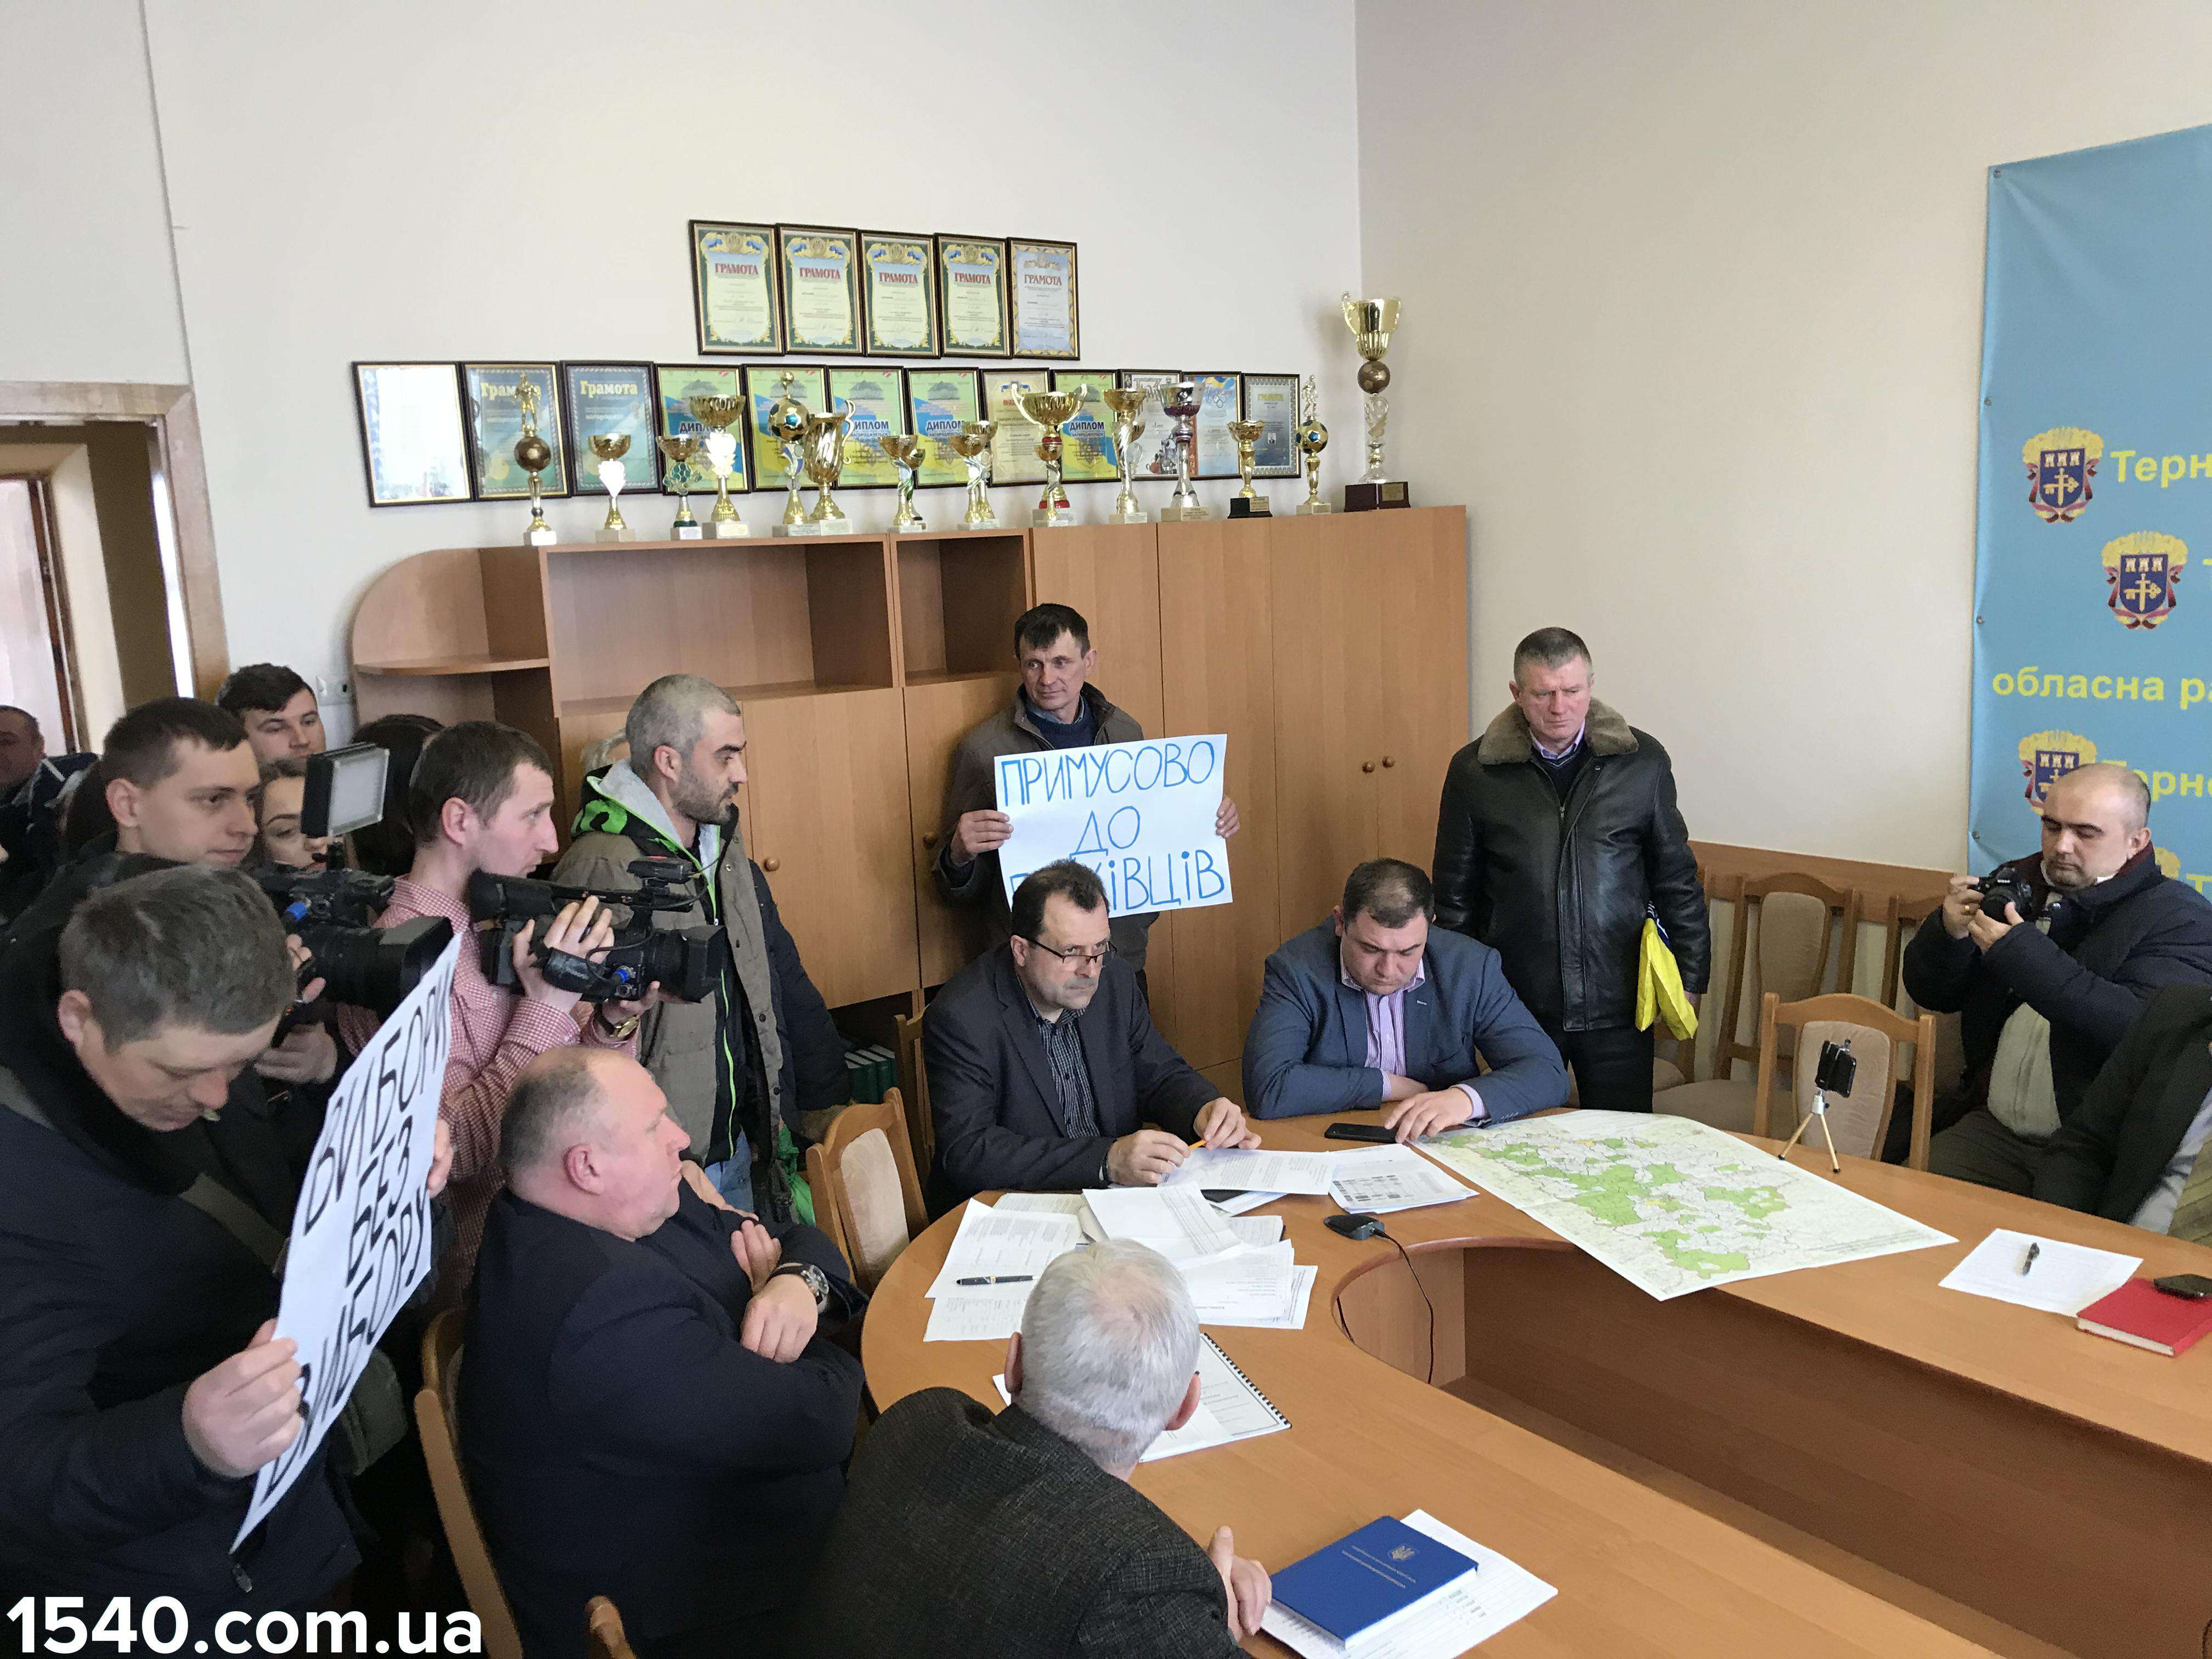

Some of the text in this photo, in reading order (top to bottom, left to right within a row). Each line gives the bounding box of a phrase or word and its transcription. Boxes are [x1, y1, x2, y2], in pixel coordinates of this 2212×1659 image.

[715, 263, 759, 275] ГРАМОТА
[799, 267, 841, 279] ГРАМОТА
[879, 272, 919, 284] ГРАМОТА
[954, 272, 991, 285] ГРАМОТА
[1024, 274, 1063, 286] ГРАМОТА
[481, 382, 541, 400] Грам
[580, 381, 638, 398] Грамота
[853, 421, 889, 431] ИПЛОМ
[1070, 421, 1104, 432] ДИПЛОМ
[1993, 665, 2212, 710] обласна р
[1001, 741, 1215, 806] ПРИМУСОВО
[1069, 805, 1141, 861] ДО
[345, 1115, 413, 1288] БЕЗ
